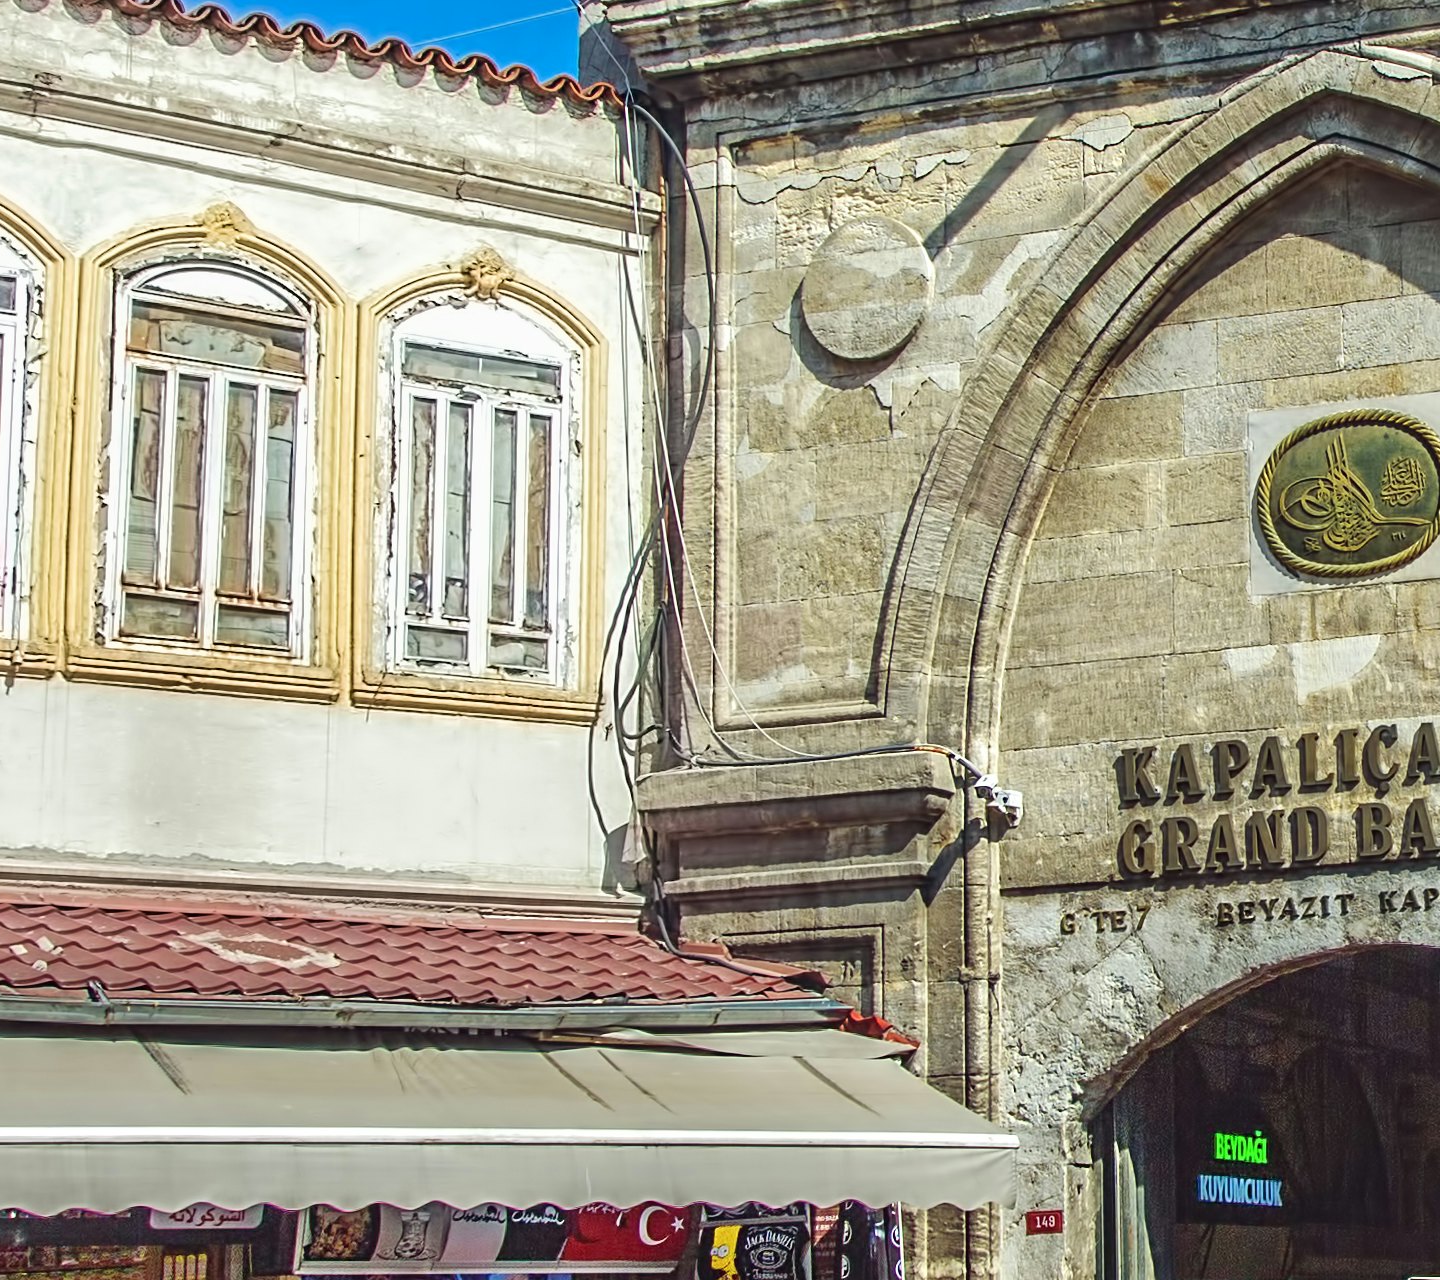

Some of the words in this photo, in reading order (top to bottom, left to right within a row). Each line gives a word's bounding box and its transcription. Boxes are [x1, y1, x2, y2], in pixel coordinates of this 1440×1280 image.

[1117, 805, 1329, 880] GRAND
[1060, 910, 1127, 935] GTE
[1136, 904, 1151, 931] 7
[1215, 892, 1355, 927] BEYAZIT
[1214, 1130, 1267, 1164] BEYDAĞI
[1197, 1174, 1282, 1207] KUYUMCULUK
[1035, 1215, 1056, 1229] 149
[745, 1234, 765, 1250] JACK
